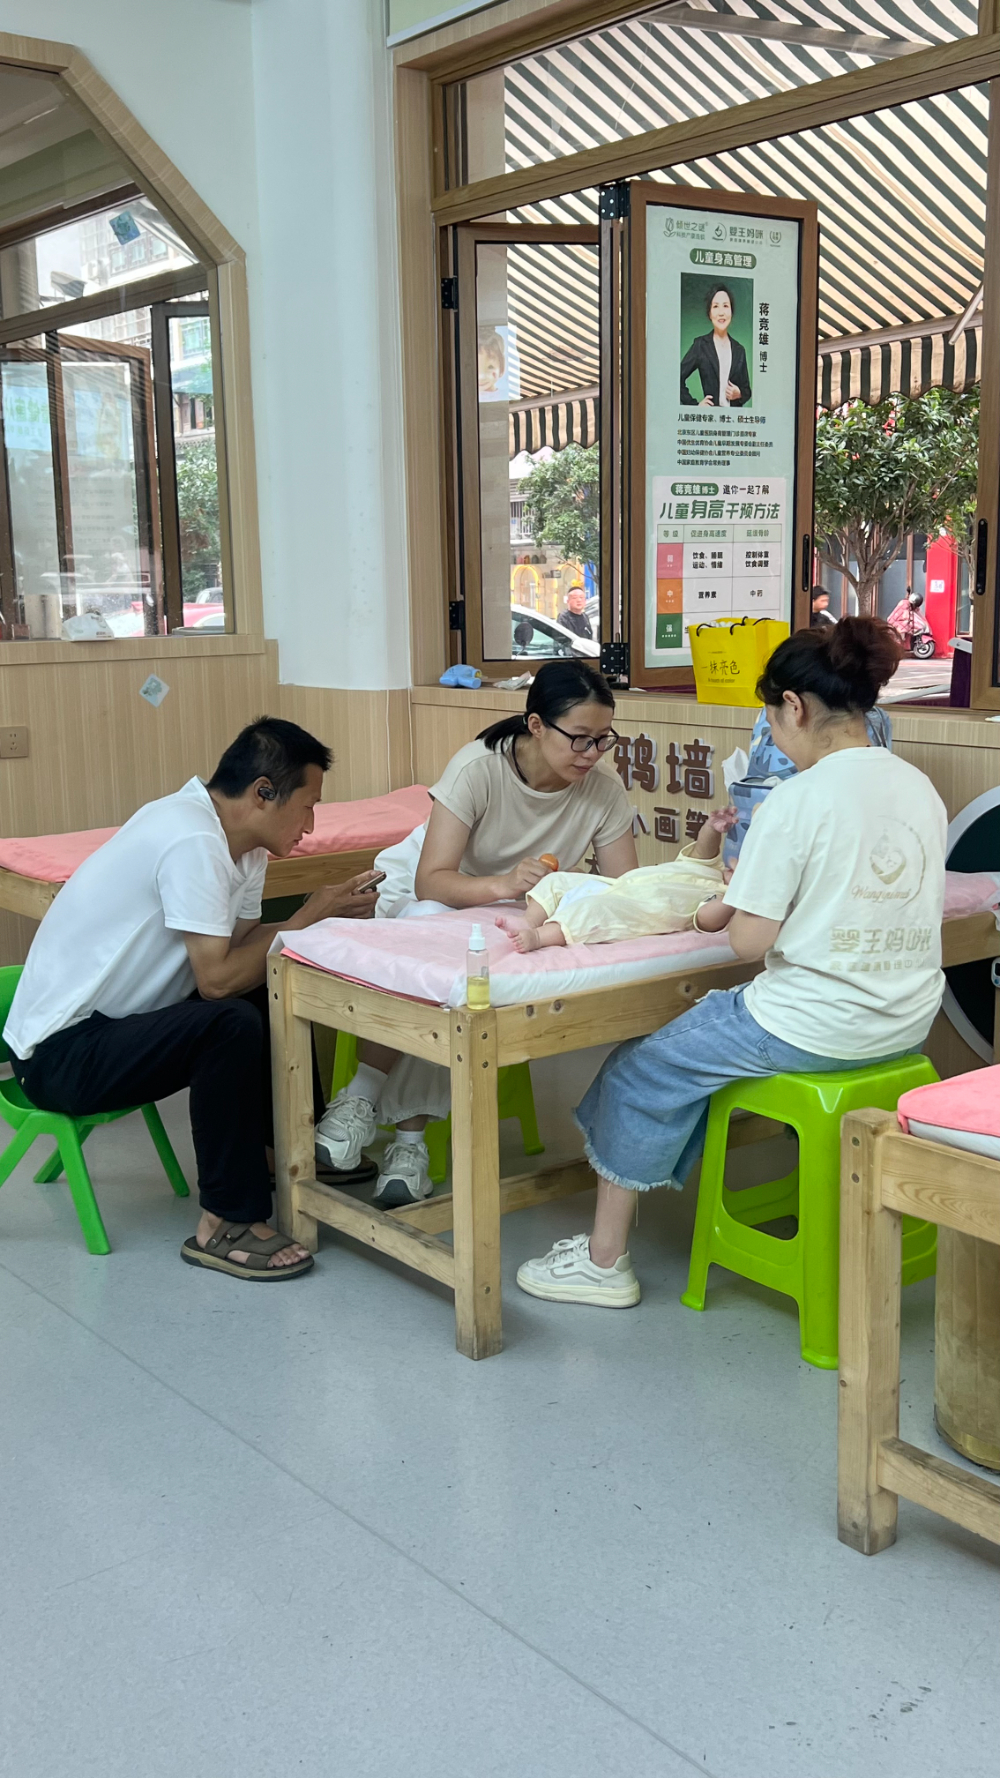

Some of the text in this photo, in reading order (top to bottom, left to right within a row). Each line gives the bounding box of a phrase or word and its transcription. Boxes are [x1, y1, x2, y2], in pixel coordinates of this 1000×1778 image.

[729, 226, 764, 240] 婴王妈咪
[695, 250, 752, 268] 儿童身高管理
[759, 302, 770, 373] 蒋竞雄 博士
[722, 485, 770, 496] 邀你一起了解
[659, 499, 780, 520] 儿童身高干预方法
[690, 530, 727, 538] 促进身高速度
[692, 551, 769, 560] 饮食、睡眠 控制体重
[692, 560, 769, 570] 运动、情绪 饮食调整
[698, 591, 717, 599] 营养素
[750, 589, 763, 597] 中药
[701, 660, 740, 675] 一抹亮色
[614, 733, 714, 799] 鸦墙
[829, 928, 932, 954] 婴王妈咪
